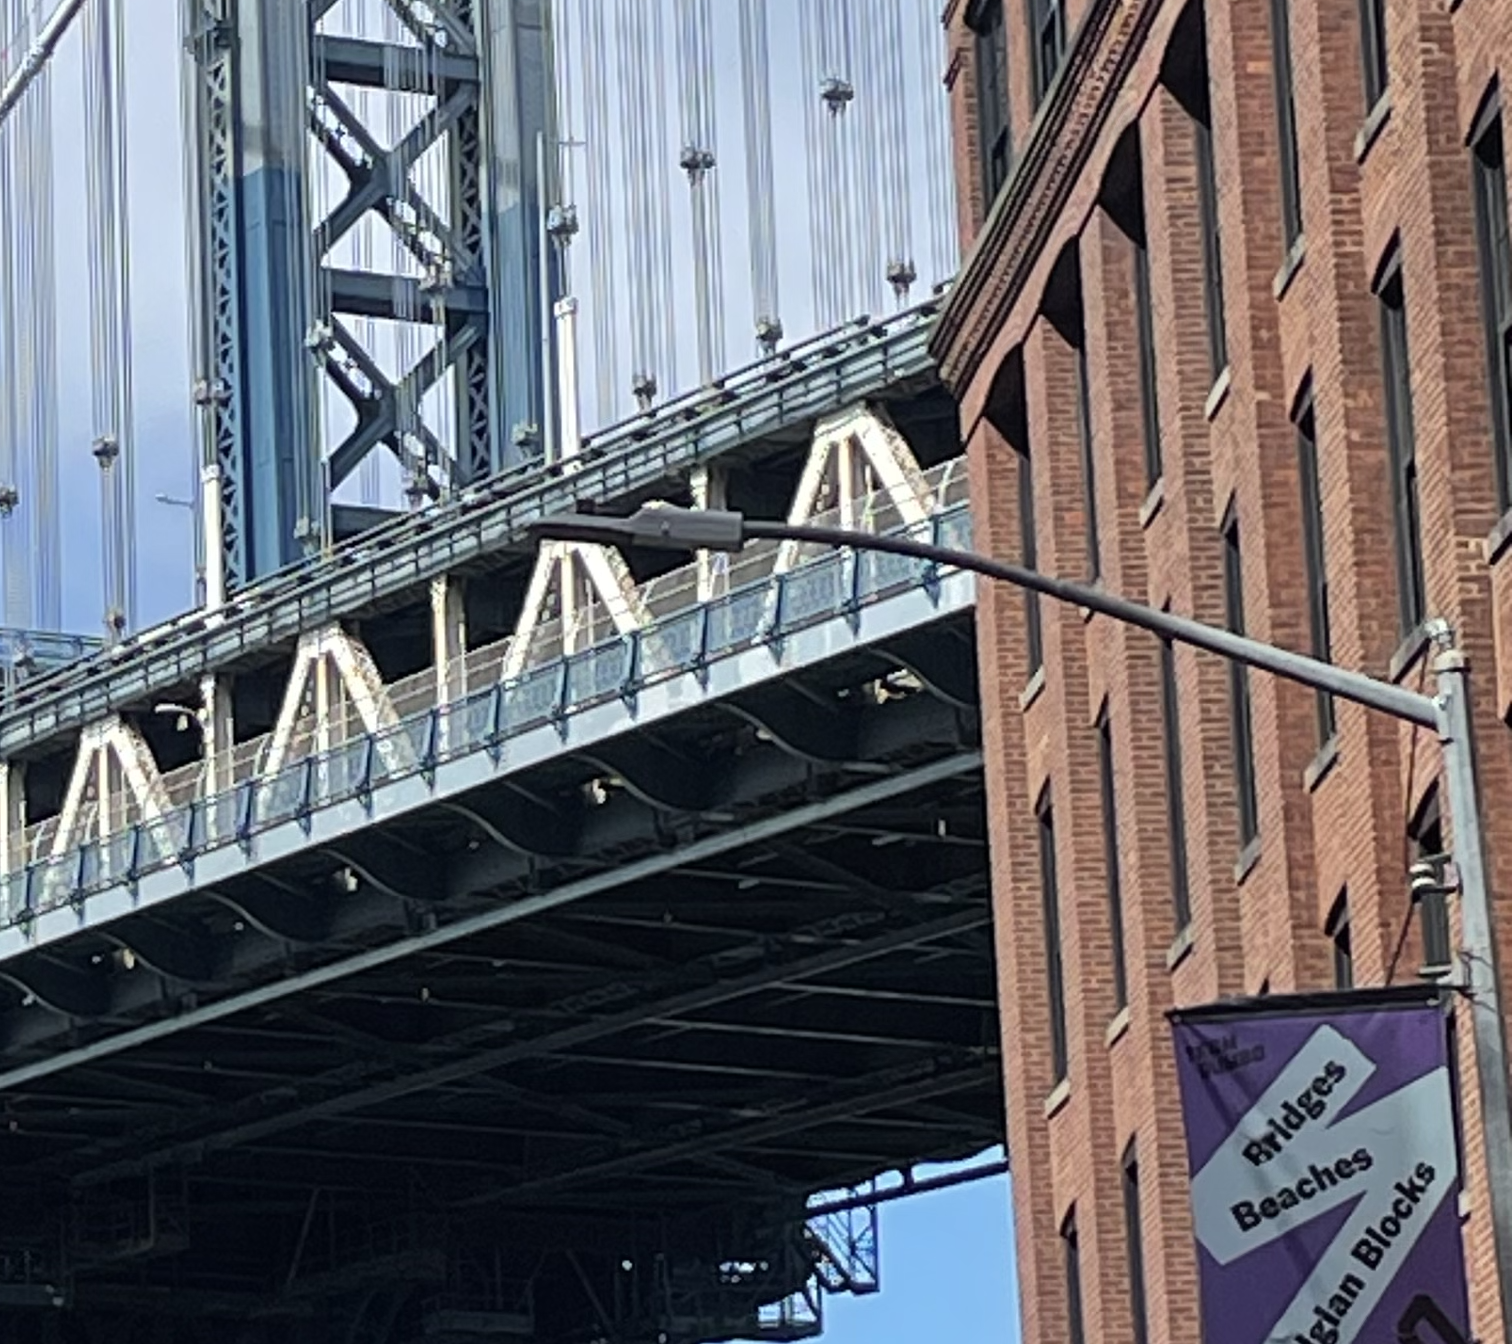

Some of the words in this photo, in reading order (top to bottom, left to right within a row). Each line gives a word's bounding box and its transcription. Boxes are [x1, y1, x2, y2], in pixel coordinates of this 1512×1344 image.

[1242, 1059, 1347, 1167] Bridges
[1230, 1147, 1373, 1232] Beaches
[1350, 1161, 1436, 1271] Blocks
